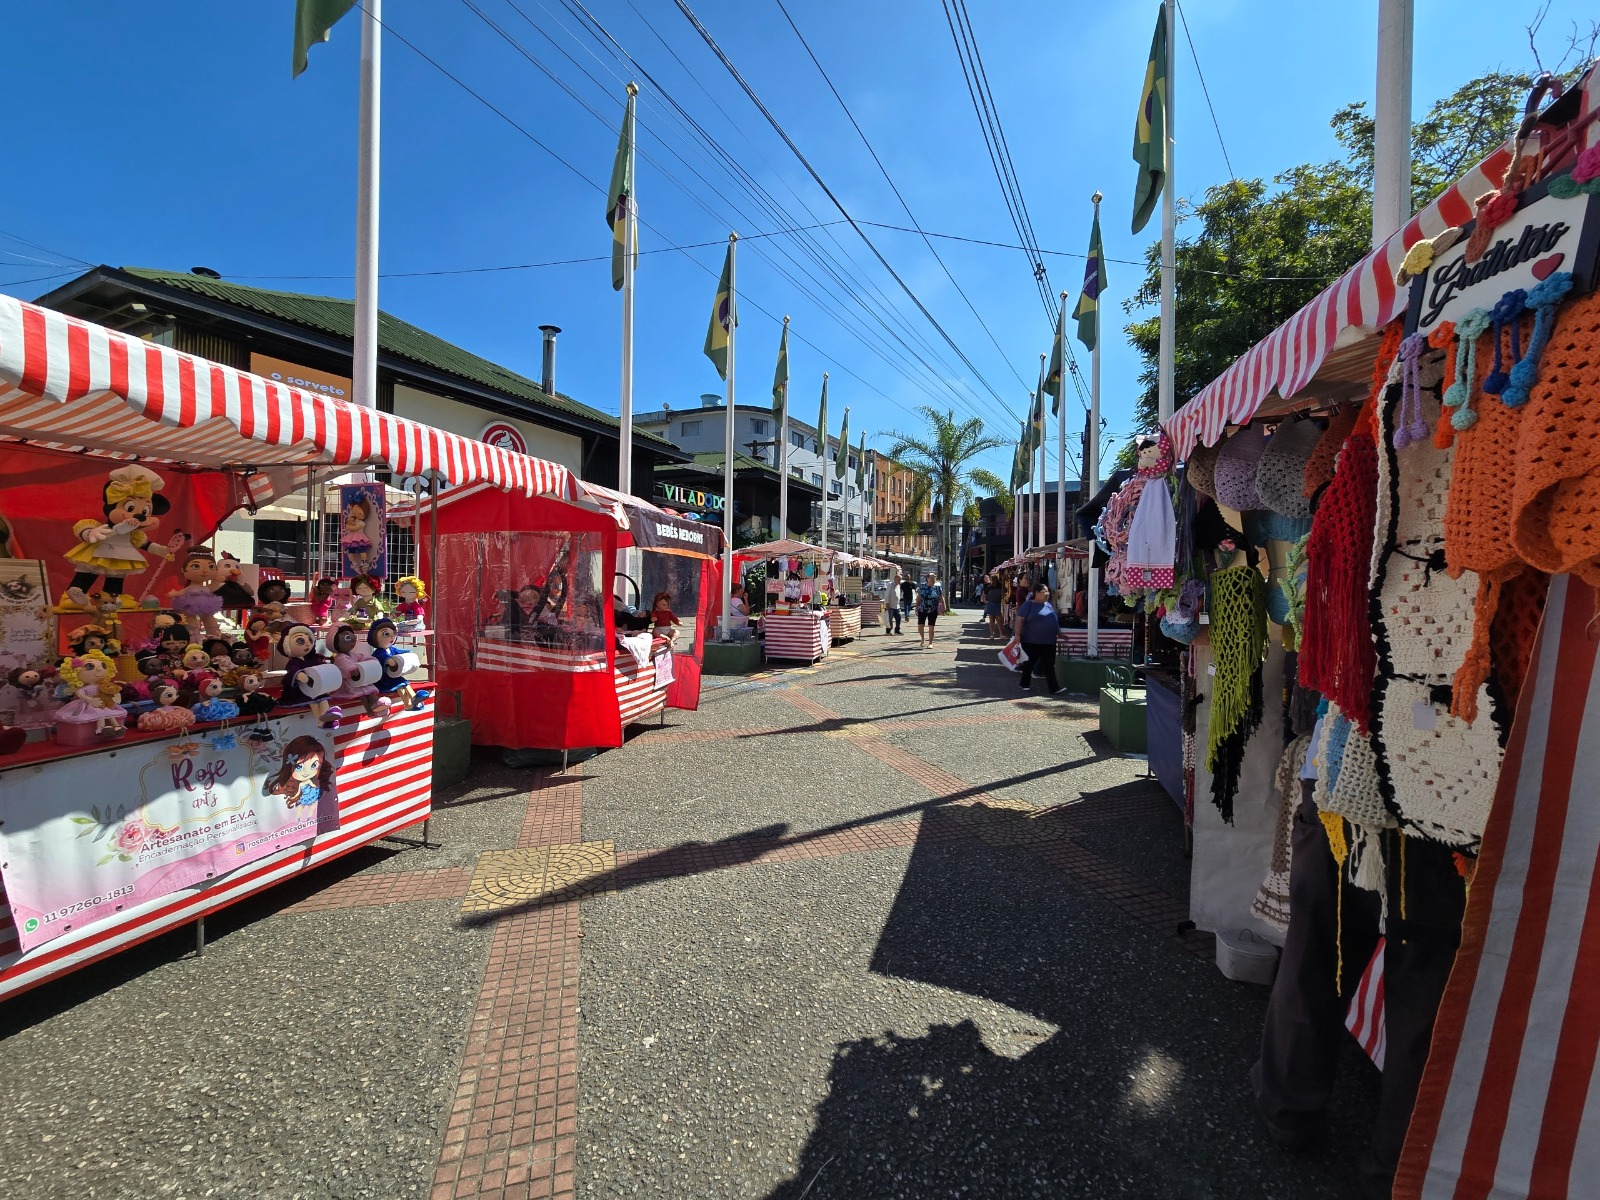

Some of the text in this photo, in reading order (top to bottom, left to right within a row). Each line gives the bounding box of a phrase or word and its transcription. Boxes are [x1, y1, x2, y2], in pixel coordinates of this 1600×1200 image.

[271, 372, 345, 396] o sorvete
[171, 758, 228, 792] Rose
[139, 820, 258, 863] Encadernação Personalizada
[140, 809, 256, 854] Artesanato em E.V.A
[247, 815, 333, 848] rosearts.encadernacao
[44, 885, 134, 924] 11 97260-1813
